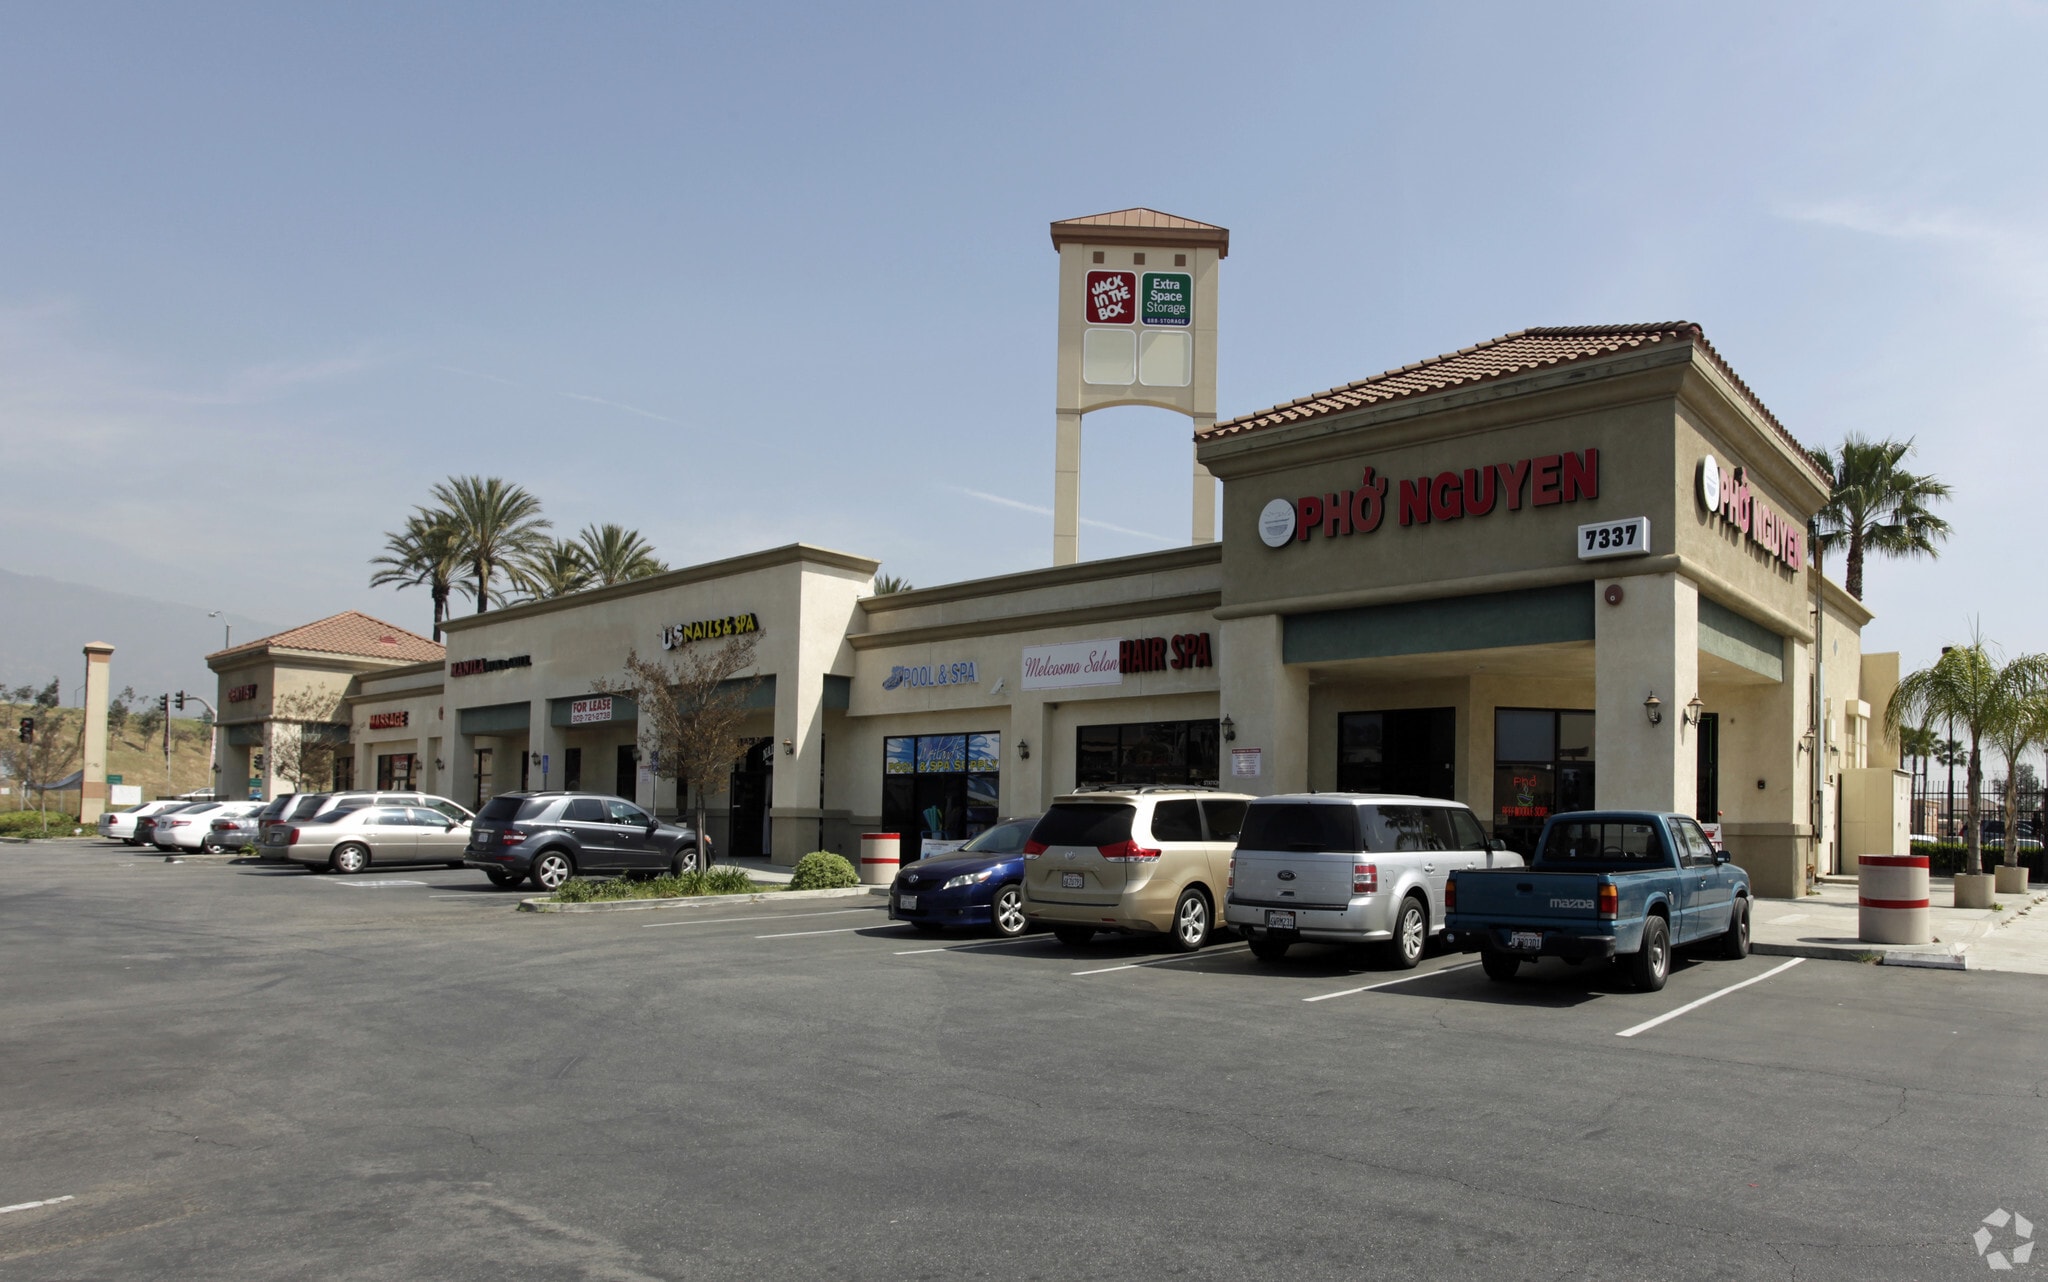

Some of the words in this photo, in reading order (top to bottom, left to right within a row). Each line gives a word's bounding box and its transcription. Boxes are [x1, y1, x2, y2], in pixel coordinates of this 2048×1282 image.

[1092, 275, 1124, 294] JACK
[1153, 278, 1180, 289] Extra
[1108, 287, 1130, 302] THE
[1151, 290, 1182, 303] Space
[1098, 302, 1124, 320] BOX
[1147, 301, 1186, 315] Storage
[1399, 448, 1598, 526] NGUYEN
[1585, 524, 1638, 551] 7337
[1752, 497, 1802, 574] NGUYEN
[662, 624, 684, 650] US
[683, 618, 723, 643] NAILS
[722, 616, 733, 635] &
[735, 613, 757, 635] SPA
[1084, 650, 1120, 674] Salon
[1119, 637, 1167, 674] HAIR
[1170, 632, 1213, 670] SPA
[903, 665, 934, 688] POOL
[938, 664, 948, 685] &
[951, 661, 976, 684] SPA
[573, 701, 587, 713] FOR
[589, 698, 611, 711] LEASE
[369, 711, 408, 729] MASSAGE
[888, 762, 914, 773] POOL
[919, 761, 927, 772] &
[929, 760, 951, 771] SPA
[1549, 898, 1595, 910] mazda
